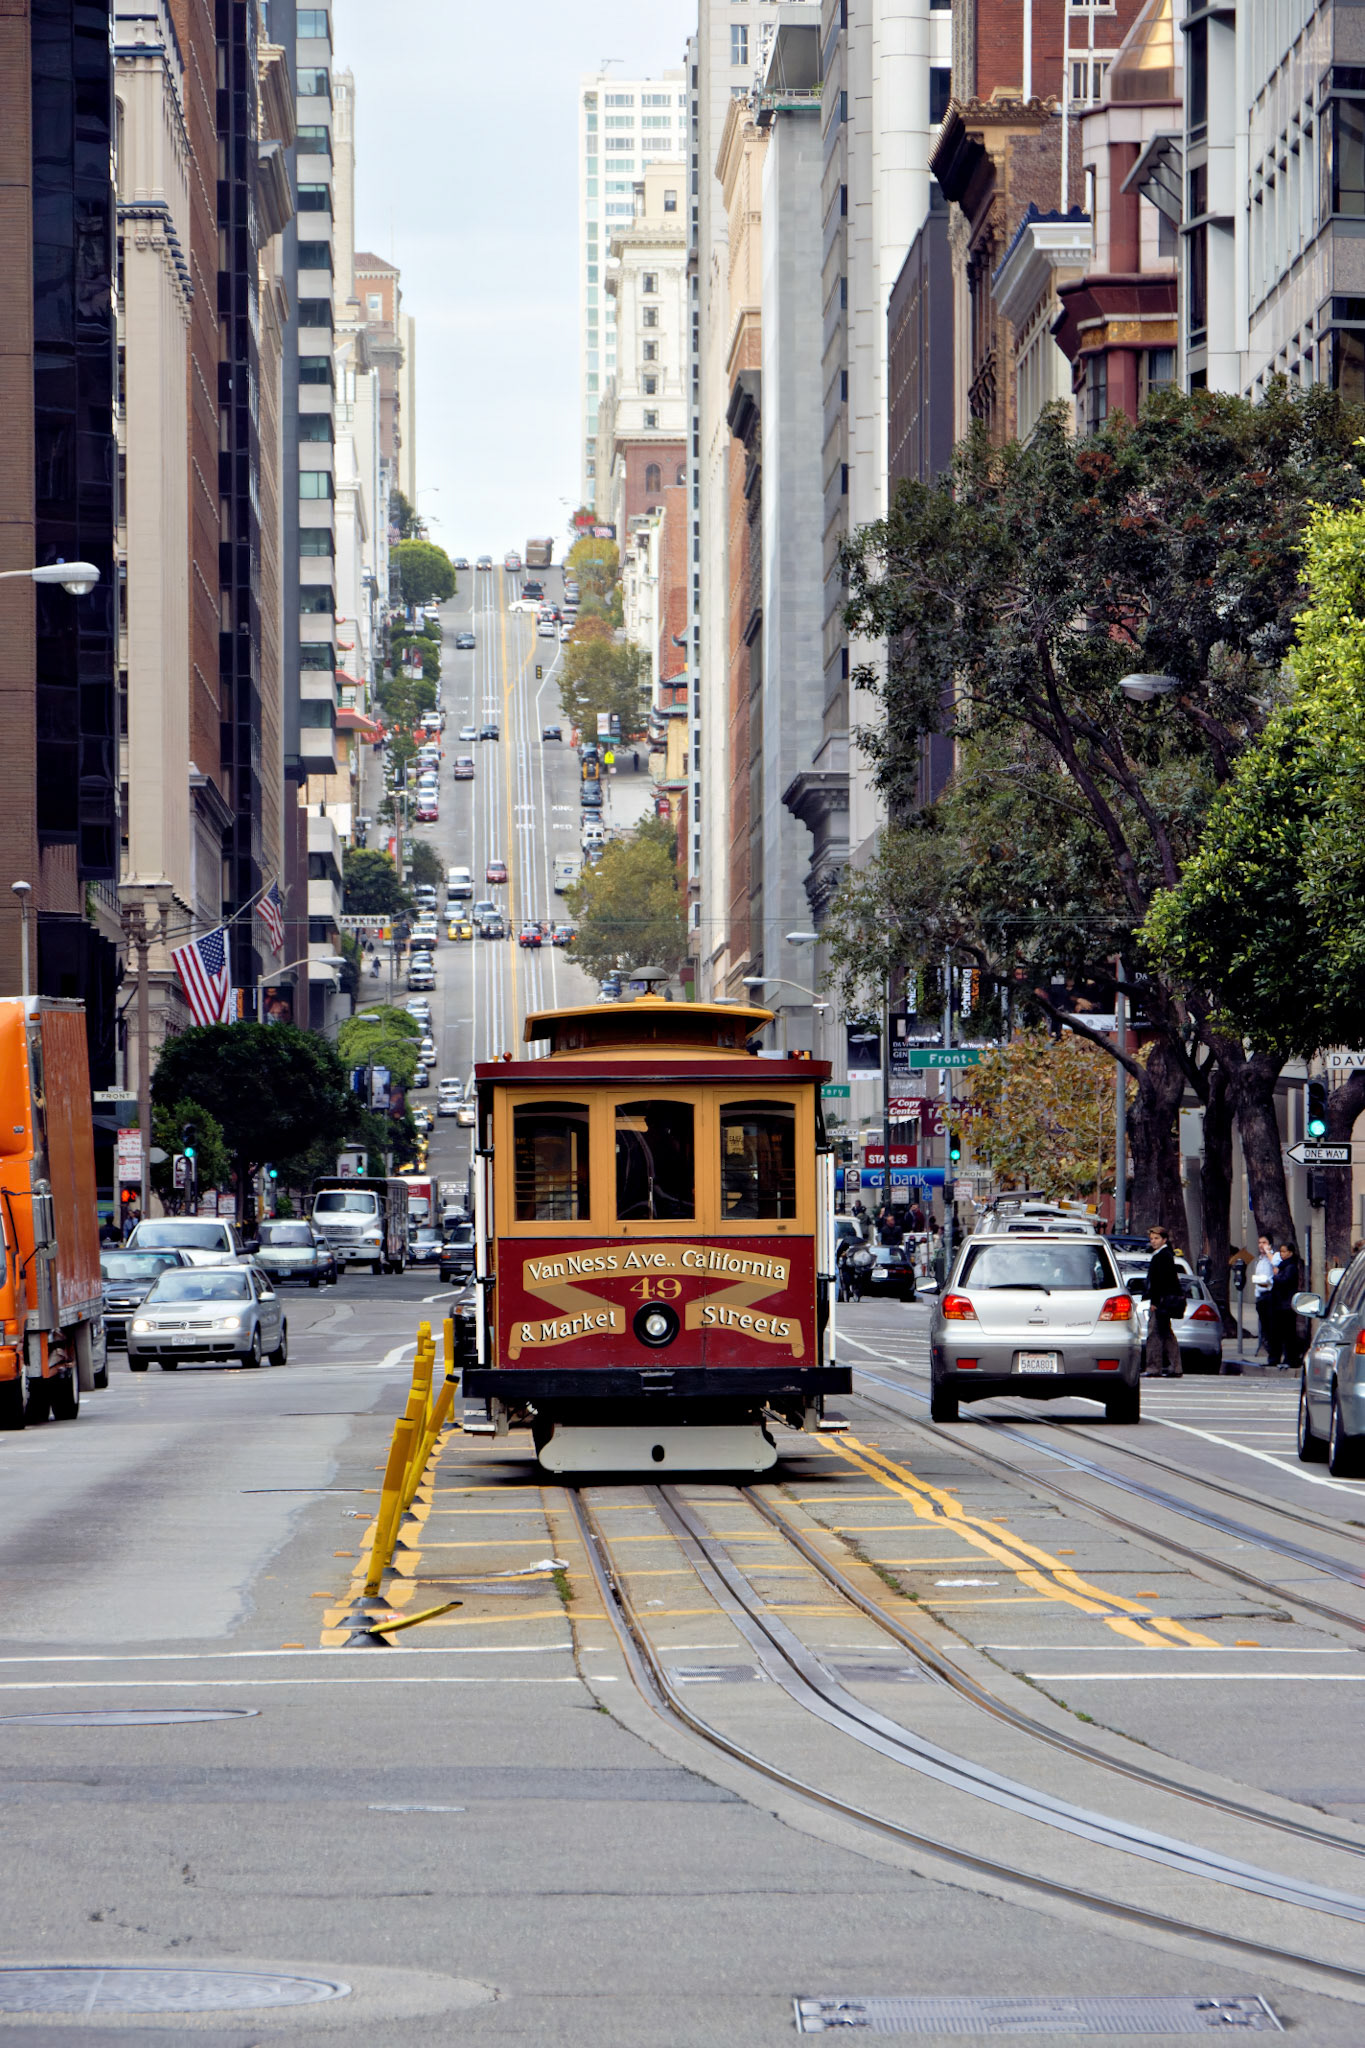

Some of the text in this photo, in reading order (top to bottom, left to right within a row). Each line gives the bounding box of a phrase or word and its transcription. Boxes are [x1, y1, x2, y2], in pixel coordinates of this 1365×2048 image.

[929, 1053, 967, 1065] Front
[897, 1099, 920, 1108] Copy
[889, 1107, 921, 1115] Center
[1304, 1149, 1345, 1158] ONE WAY
[869, 1172, 926, 1186] ciibank
[528, 1262, 565, 1281] Van
[567, 1251, 618, 1275] Ness
[681, 1250, 787, 1280] California
[629, 1276, 683, 1300] 49
[520, 1305, 792, 1343] & Market Streets
